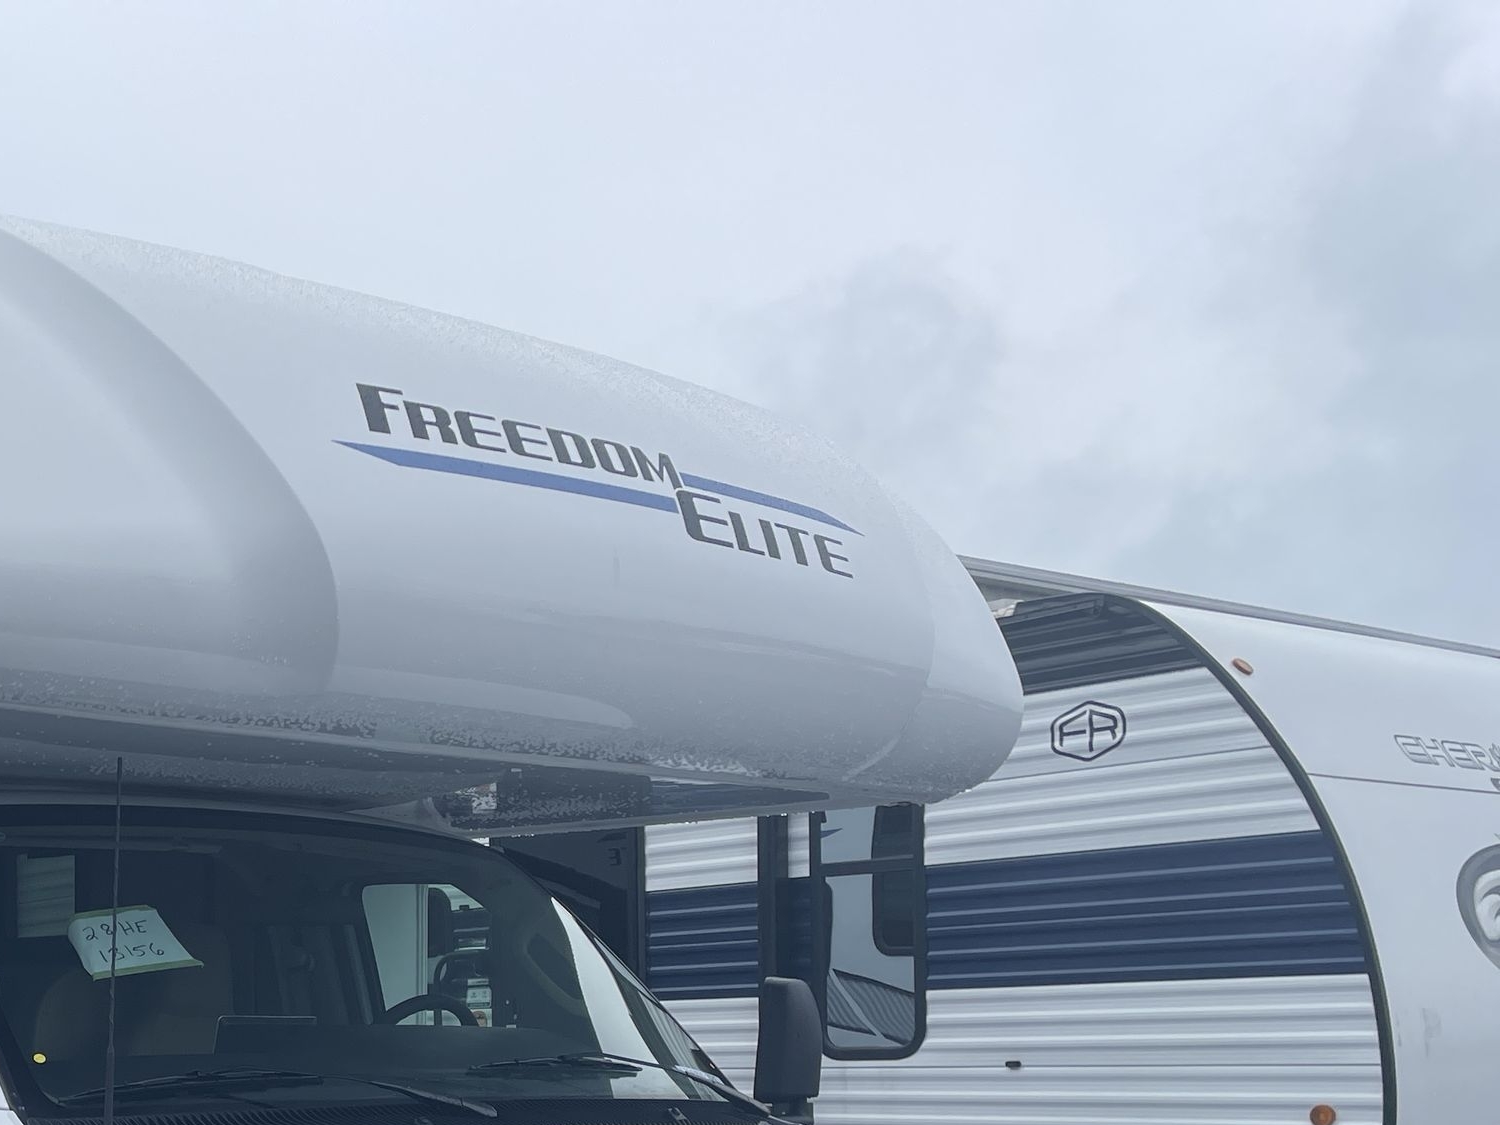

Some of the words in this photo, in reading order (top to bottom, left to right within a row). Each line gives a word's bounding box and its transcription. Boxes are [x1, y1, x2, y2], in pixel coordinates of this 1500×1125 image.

[355, 383, 683, 490] FREEDOM
[676, 489, 854, 579] ELITE
[1058, 708, 1118, 752] FR
[98, 943, 165, 963] 13156
